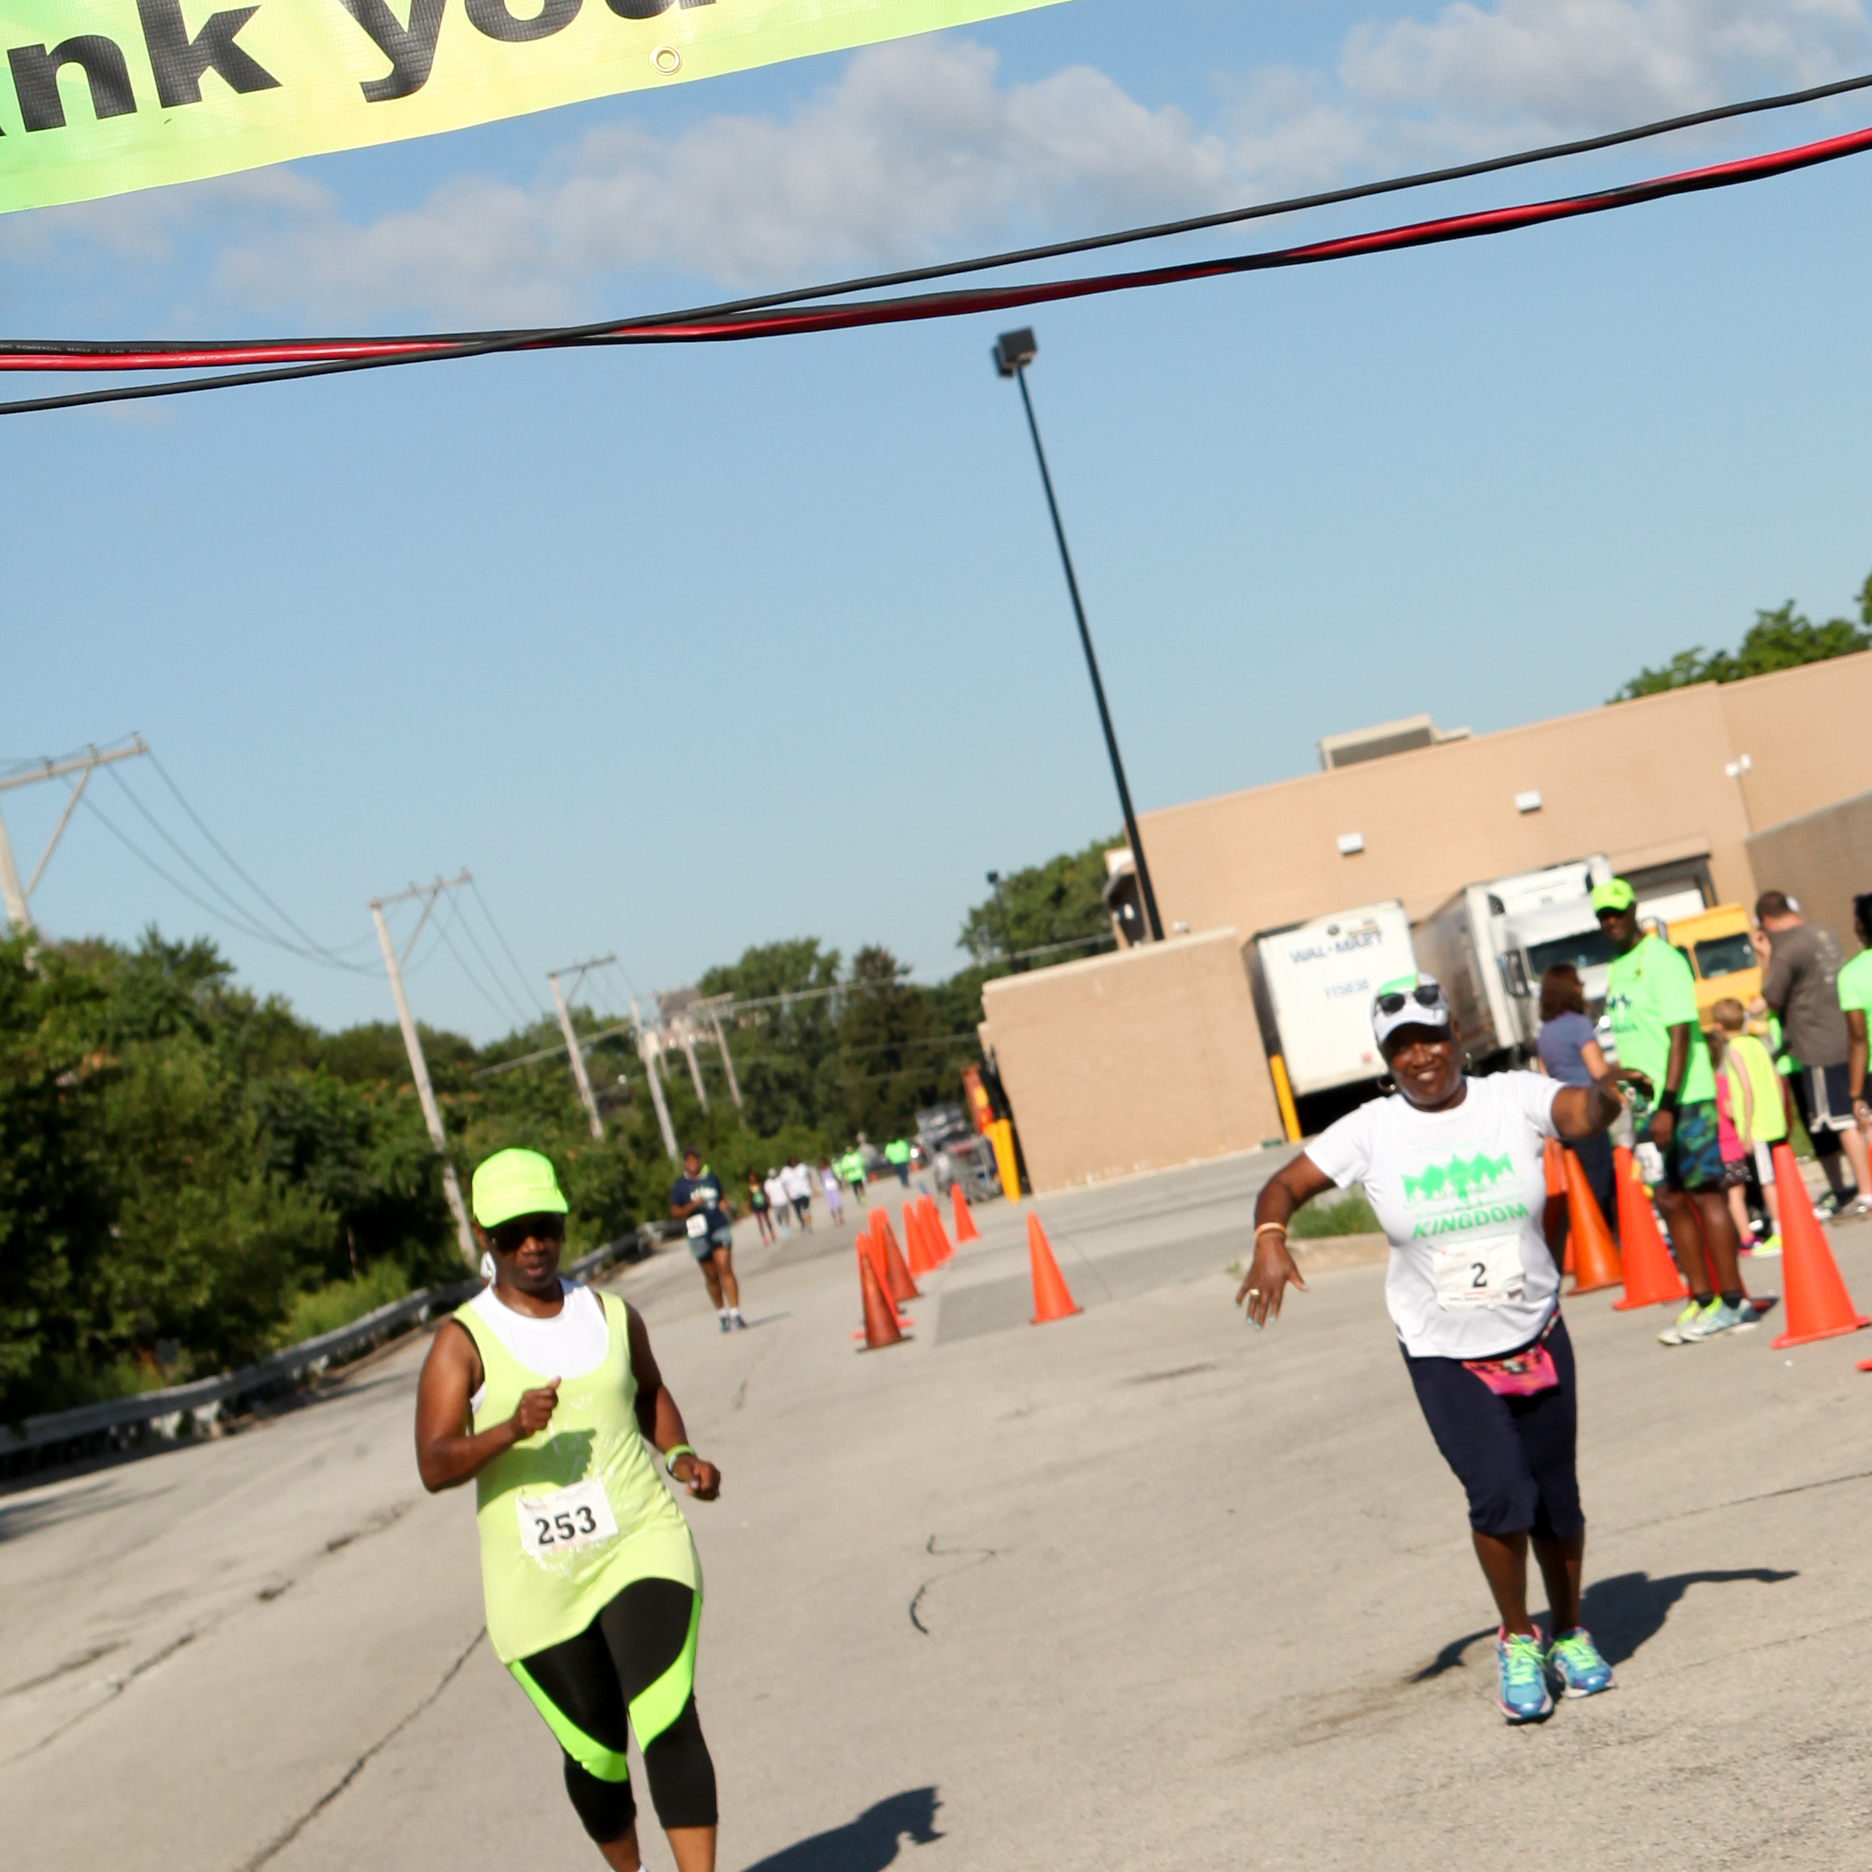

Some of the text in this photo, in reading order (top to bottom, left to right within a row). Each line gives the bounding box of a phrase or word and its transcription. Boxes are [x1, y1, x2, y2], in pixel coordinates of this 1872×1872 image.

[1412, 1202, 1529, 1240] KINGDOM
[1470, 1262, 1487, 1288] 2
[535, 1506, 597, 1545] 253
